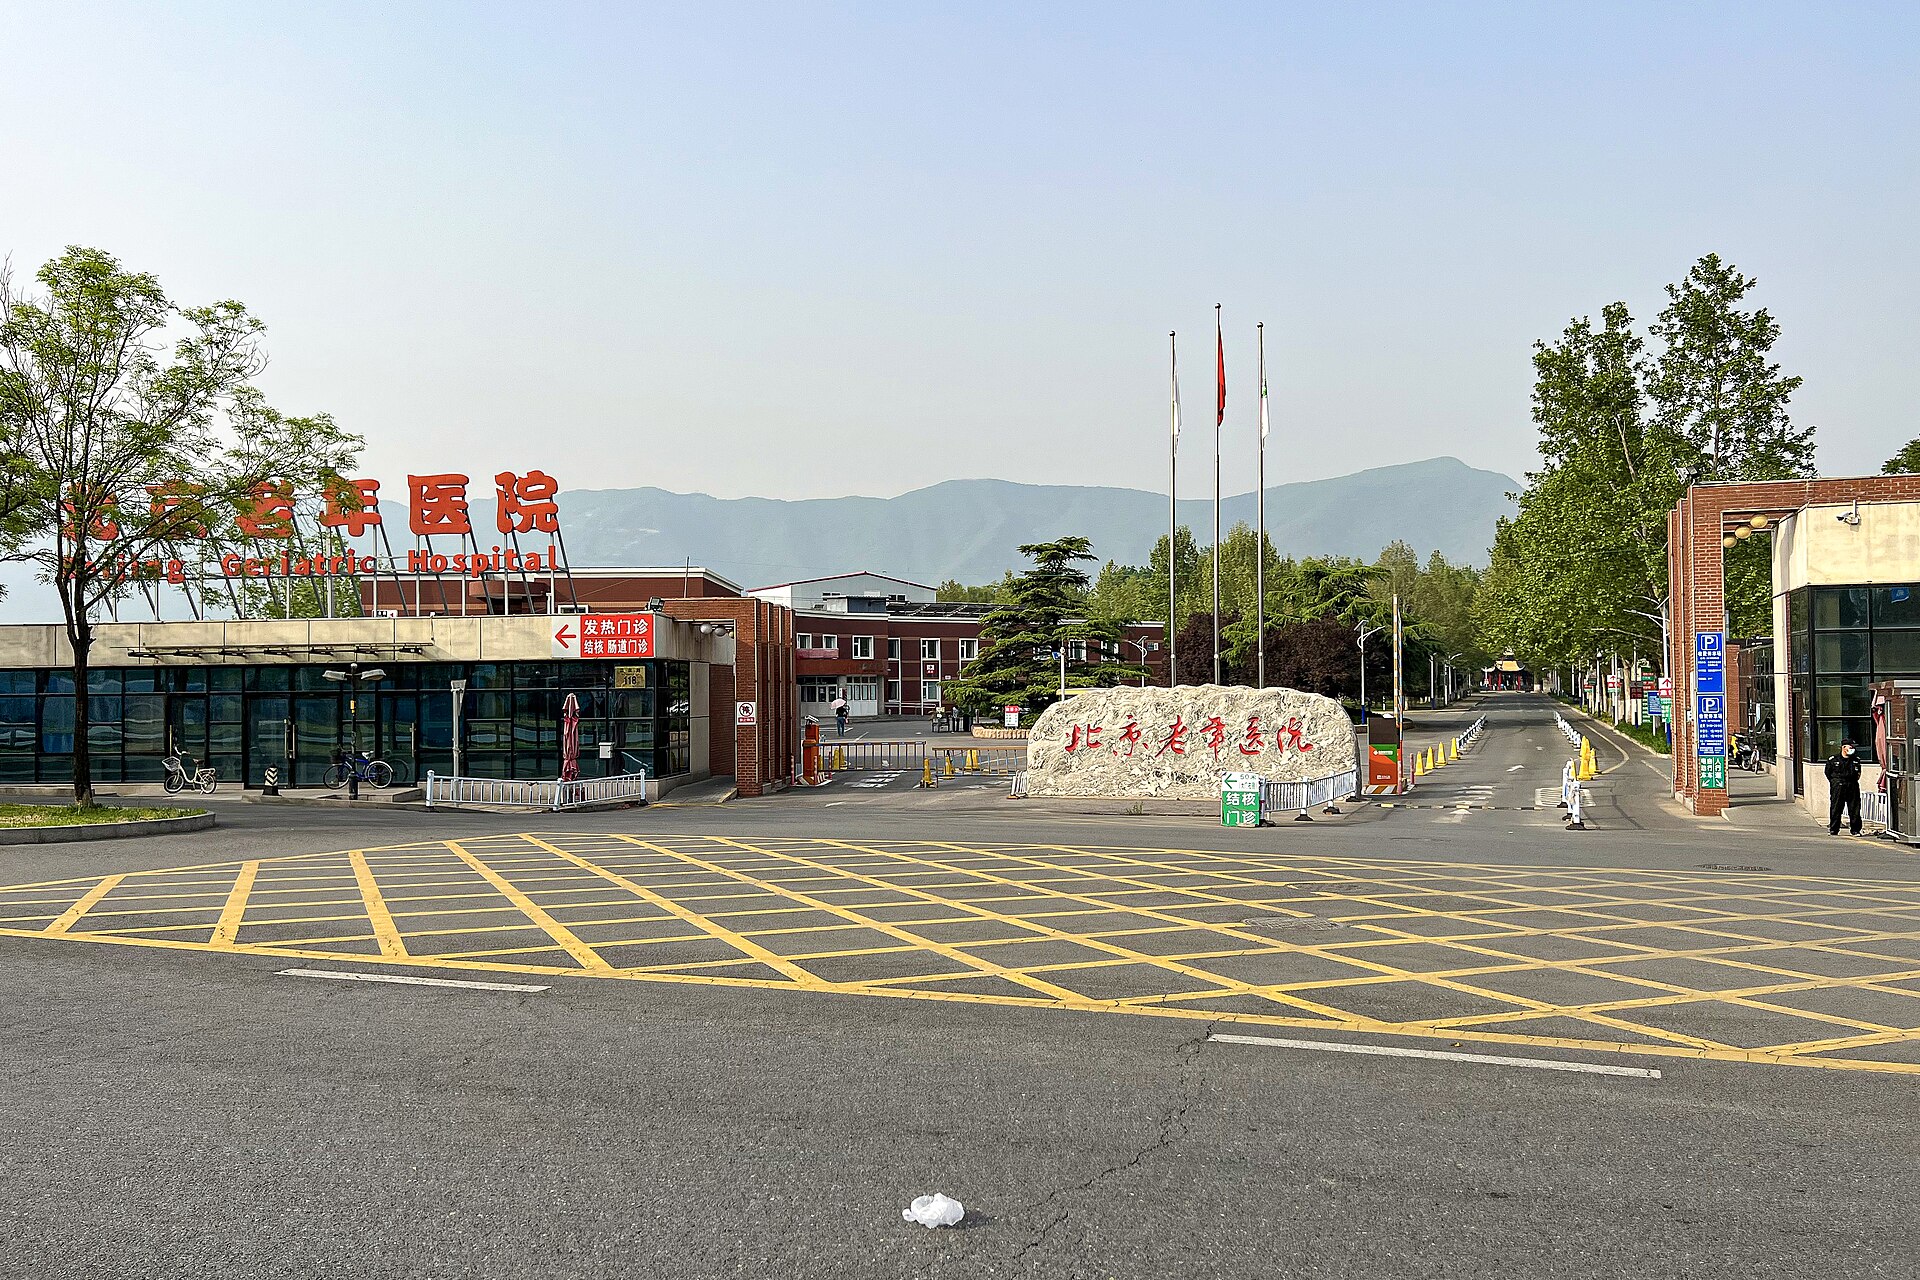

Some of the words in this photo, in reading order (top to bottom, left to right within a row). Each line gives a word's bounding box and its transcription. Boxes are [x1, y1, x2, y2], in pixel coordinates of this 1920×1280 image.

[222, 548, 376, 577] Geriatric
[408, 545, 558, 578] Hospital
[583, 619, 649, 635] 发热门诊
[583, 639, 604, 655] 结核
[607, 638, 648, 655] 肠道门诊
[623, 675, 637, 685] 118
[1064, 714, 1314, 763] 北京老年医院
[1226, 792, 1256, 806] 结核
[1226, 810, 1256, 825] 门诊
